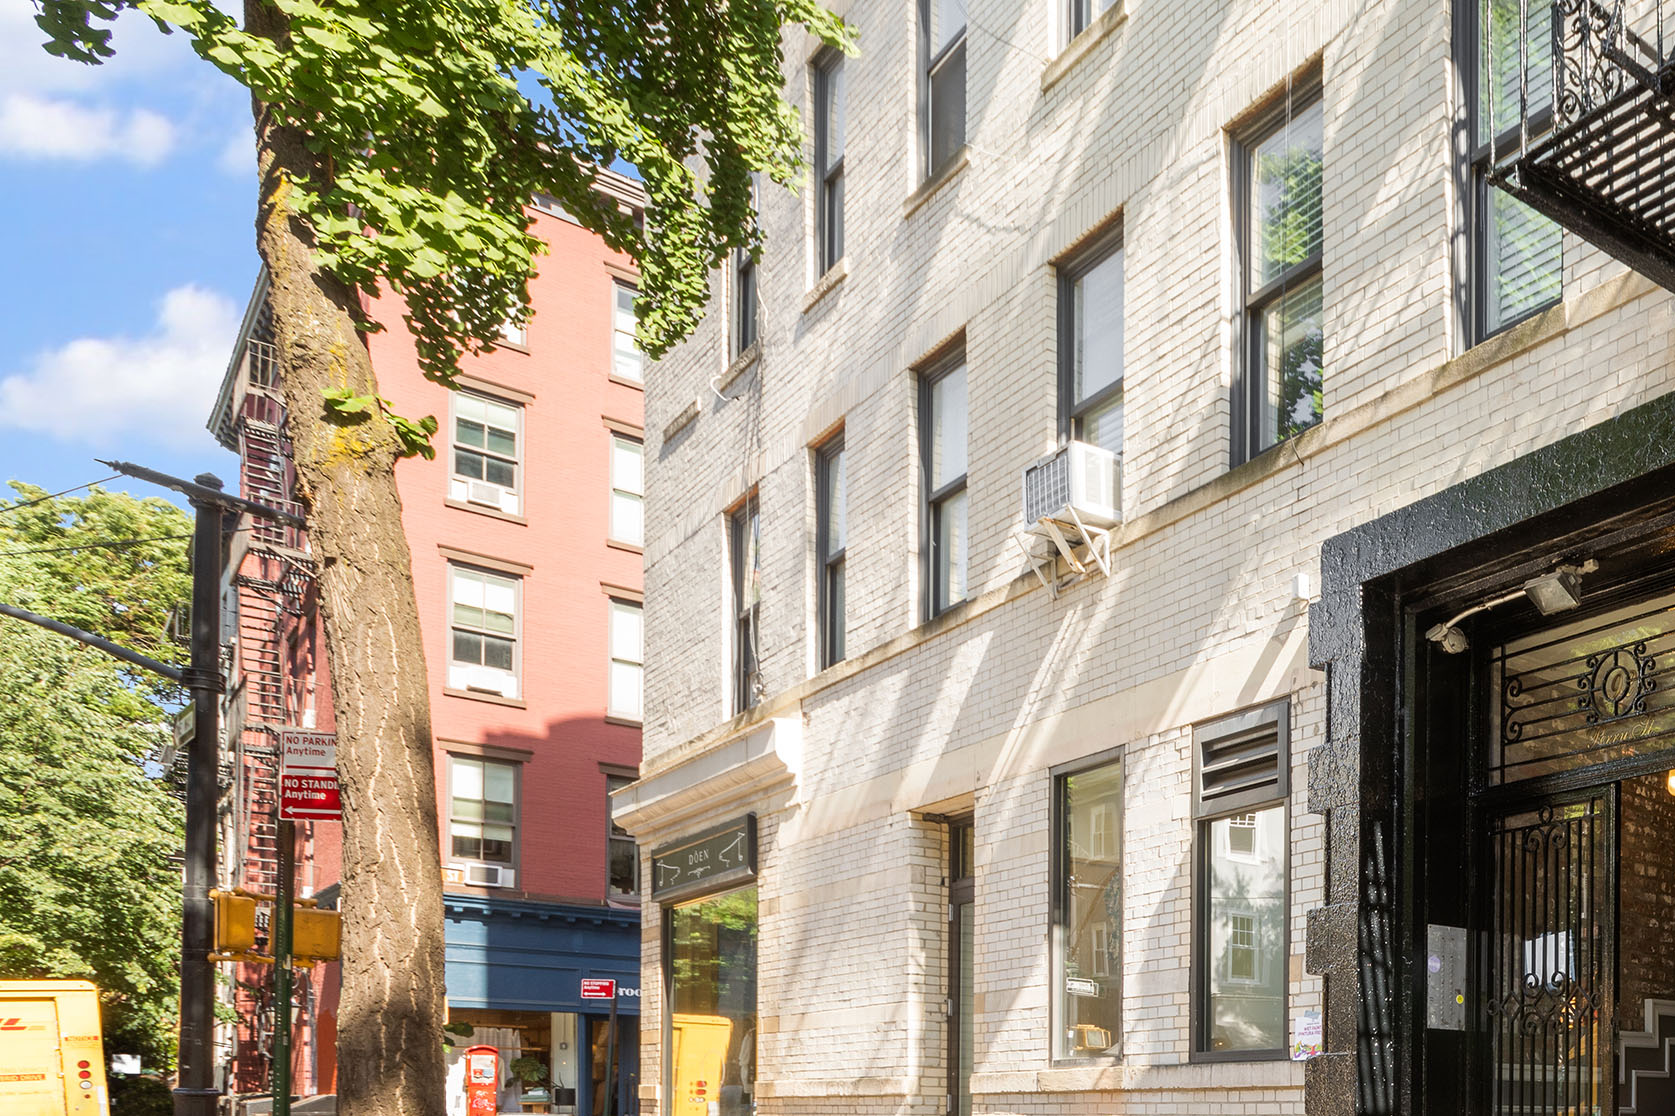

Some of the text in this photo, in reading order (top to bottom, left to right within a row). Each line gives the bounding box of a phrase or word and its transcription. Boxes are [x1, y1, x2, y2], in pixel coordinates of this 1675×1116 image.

[286, 736, 337, 747] NO PARKIN
[286, 746, 326, 757] Anytime
[284, 778, 340, 790] NO STANDI
[285, 789, 327, 800] Anytime
